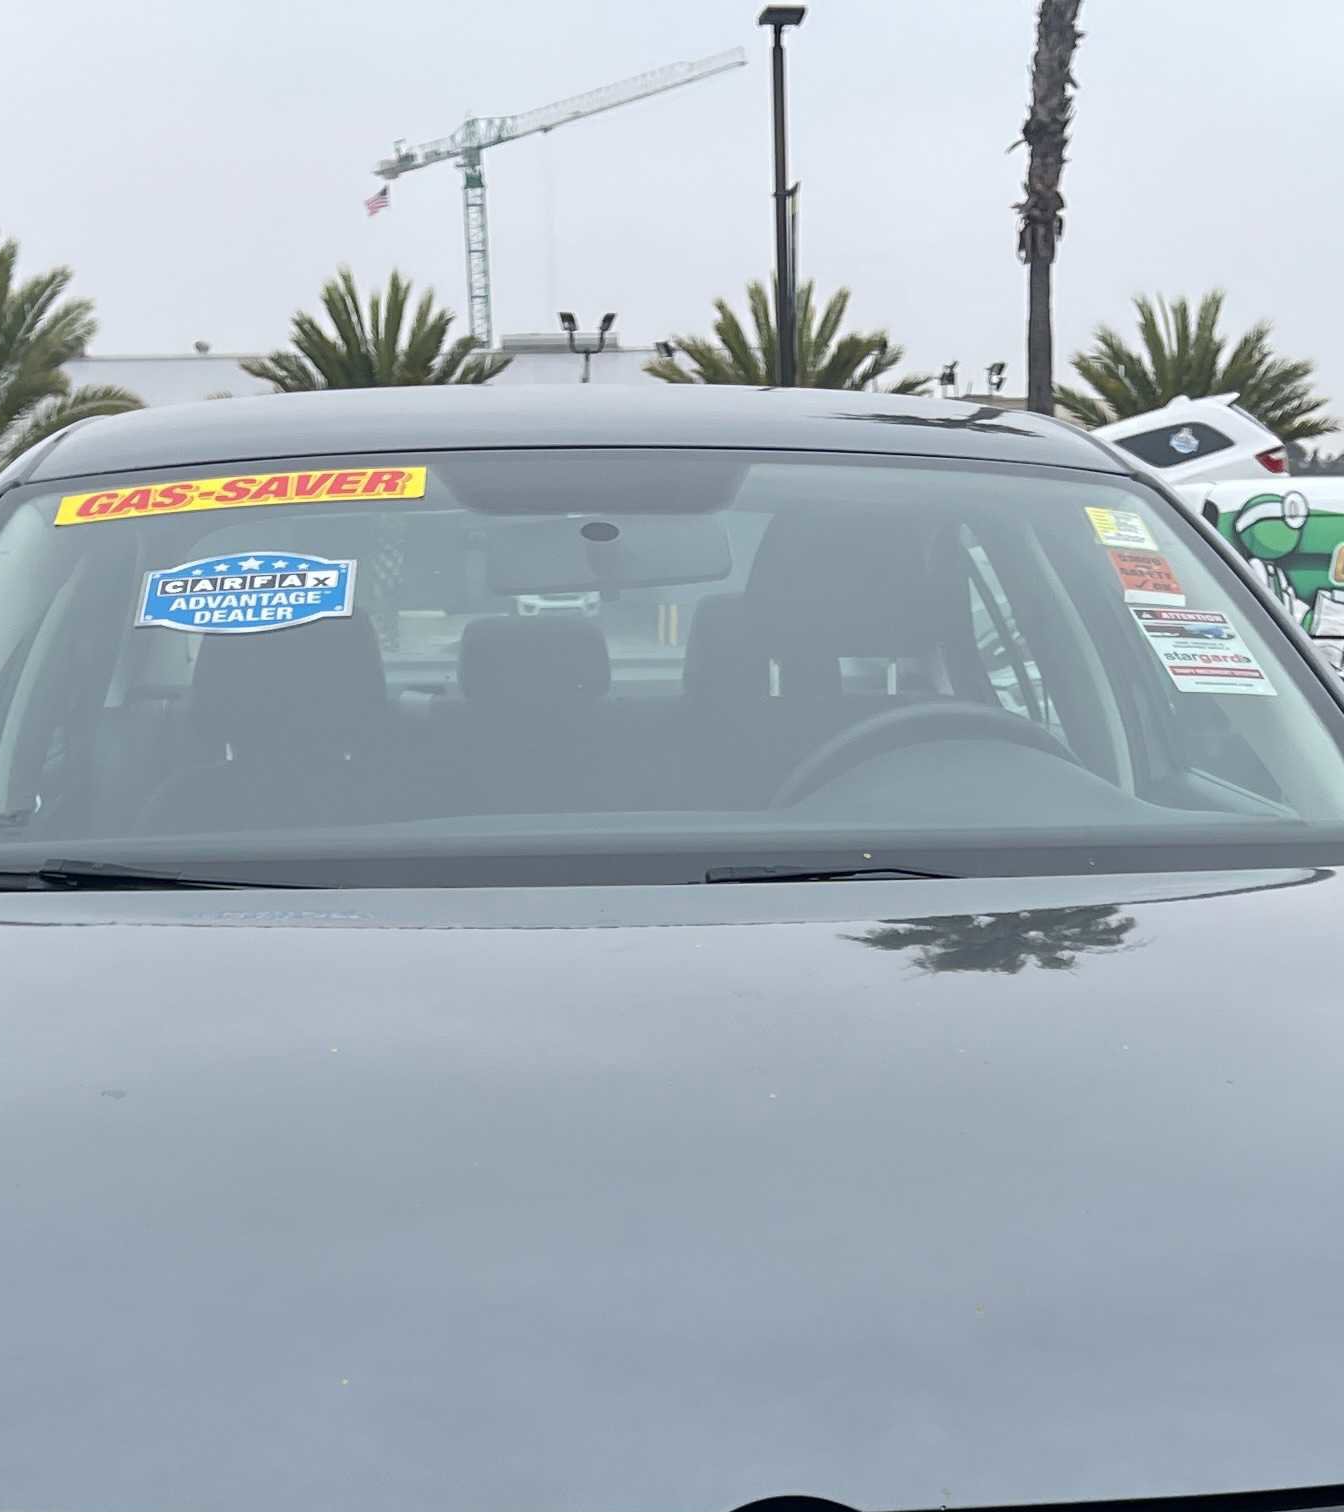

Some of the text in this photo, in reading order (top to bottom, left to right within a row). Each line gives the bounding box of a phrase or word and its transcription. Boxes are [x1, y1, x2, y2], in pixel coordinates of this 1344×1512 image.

[75, 470, 412, 518] GAS-SAVER
[162, 572, 334, 595] CARFAX
[169, 592, 322, 612] ADVANTAGE
[194, 607, 293, 625] DEALER
